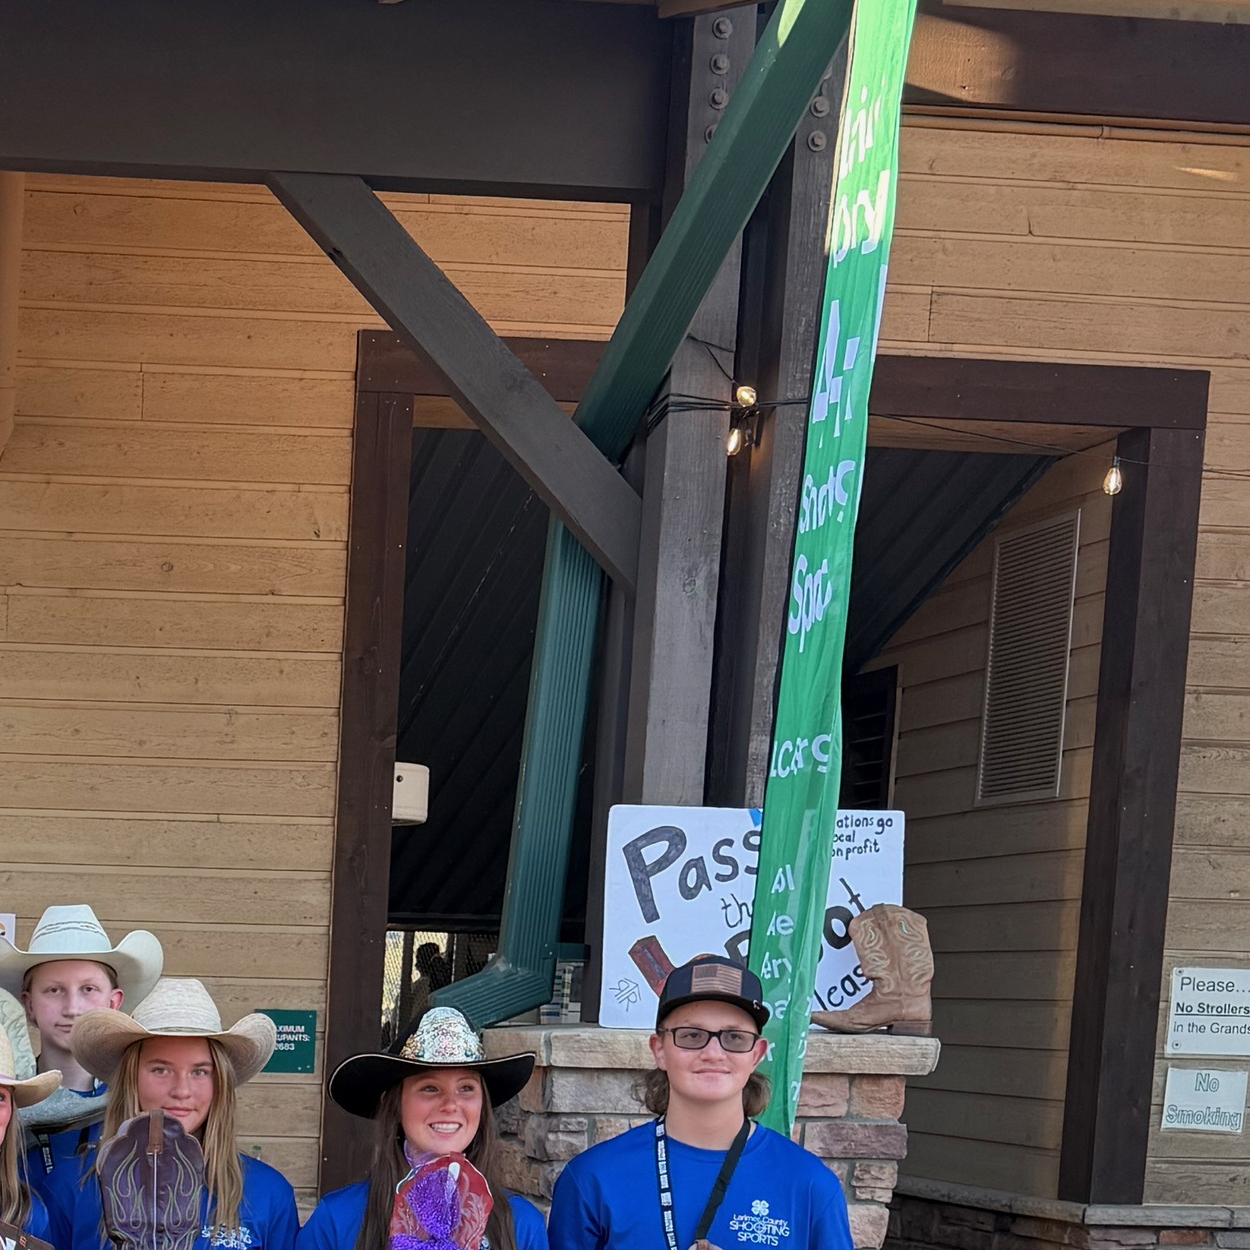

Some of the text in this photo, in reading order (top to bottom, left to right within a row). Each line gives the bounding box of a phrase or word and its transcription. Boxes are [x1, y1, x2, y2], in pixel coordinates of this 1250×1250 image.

[875, 817, 893, 835] go
[720, 893, 755, 929] th
[1176, 1002, 1250, 1016] No Strollers
[1173, 1022, 1183, 1033] in
[1188, 1022, 1206, 1034] the
[1195, 1073, 1220, 1092] No
[1166, 1104, 1241, 1131] Smoking
[729, 1220, 790, 1238] SHOOTING
[733, 1213, 789, 1228] Larimer County
[737, 1231, 779, 1247] SPORTS
